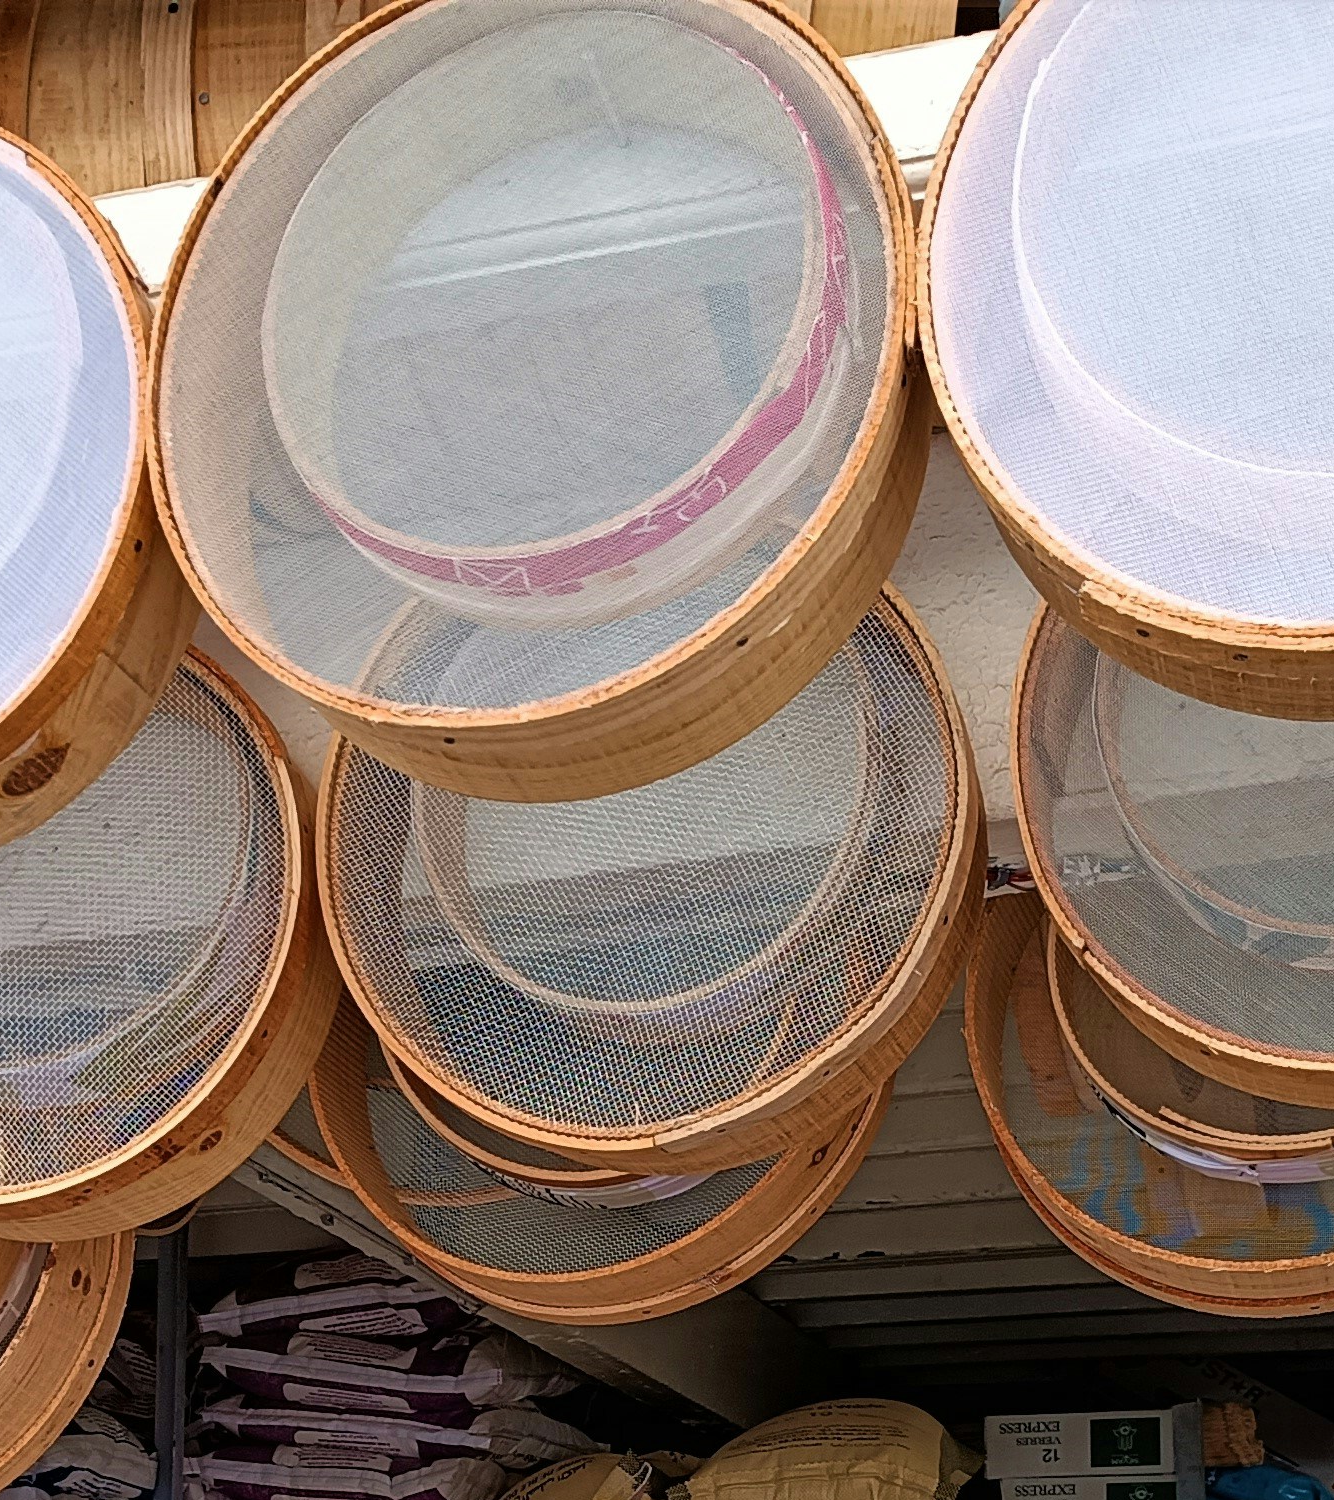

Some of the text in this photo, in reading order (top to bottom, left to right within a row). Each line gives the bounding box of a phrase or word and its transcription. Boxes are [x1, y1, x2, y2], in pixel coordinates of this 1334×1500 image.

[999, 1421, 1060, 1434] EXPRESS
[1016, 1436, 1061, 1446] VERRES
[1042, 1449, 1060, 1463] 12
[1015, 1484, 1076, 1497] EXPRESS
